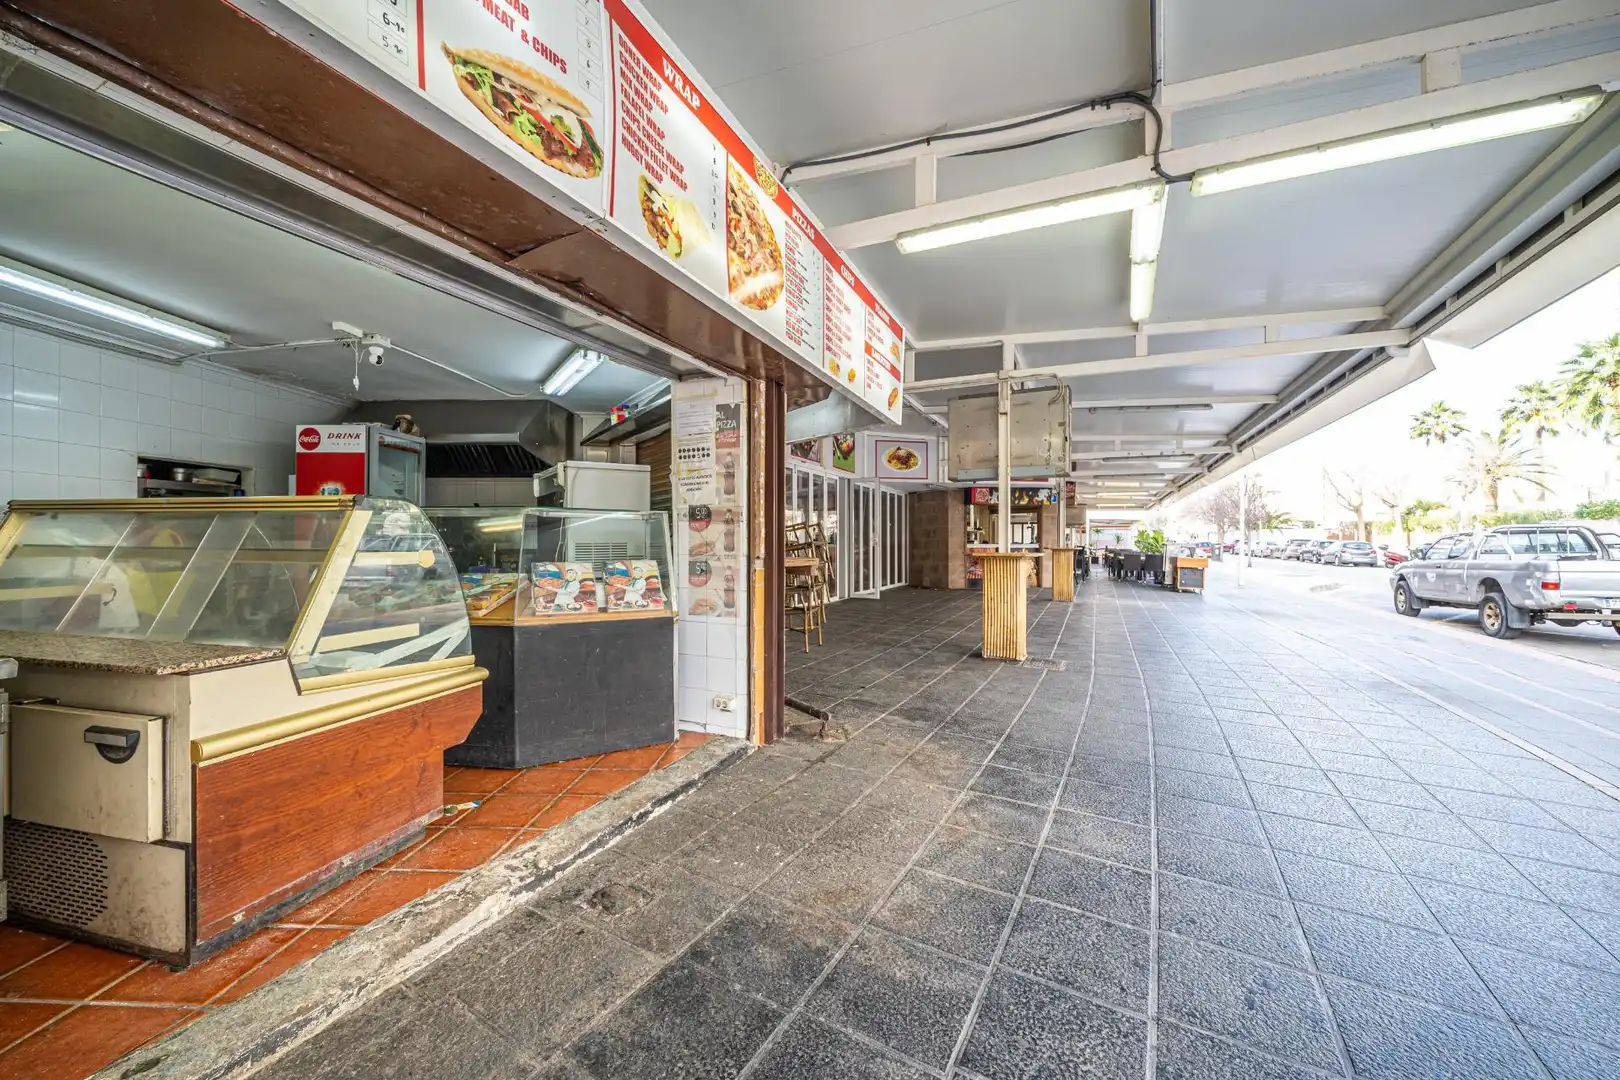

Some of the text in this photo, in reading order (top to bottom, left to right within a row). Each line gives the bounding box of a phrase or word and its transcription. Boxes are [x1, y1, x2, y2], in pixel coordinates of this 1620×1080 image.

[532, 36, 567, 74] CHIPS
[618, 33, 663, 91] DONER WRAP
[619, 49, 669, 115] CHICKEN WRAP
[620, 66, 654, 113] MIX WRAP
[662, 56, 701, 111] WRAP
[621, 83, 666, 141] FALAFEL WRAP
[621, 116, 688, 193] CHICKEN FILLET WRAP
[642, 124, 665, 158] CHEESE
[666, 148, 685, 175] WRAP
[644, 157, 664, 184] WRAP
[792, 205, 815, 241] PIZZAS
[327, 432, 362, 440] DRINK
[716, 420, 737, 429] PIZZA
